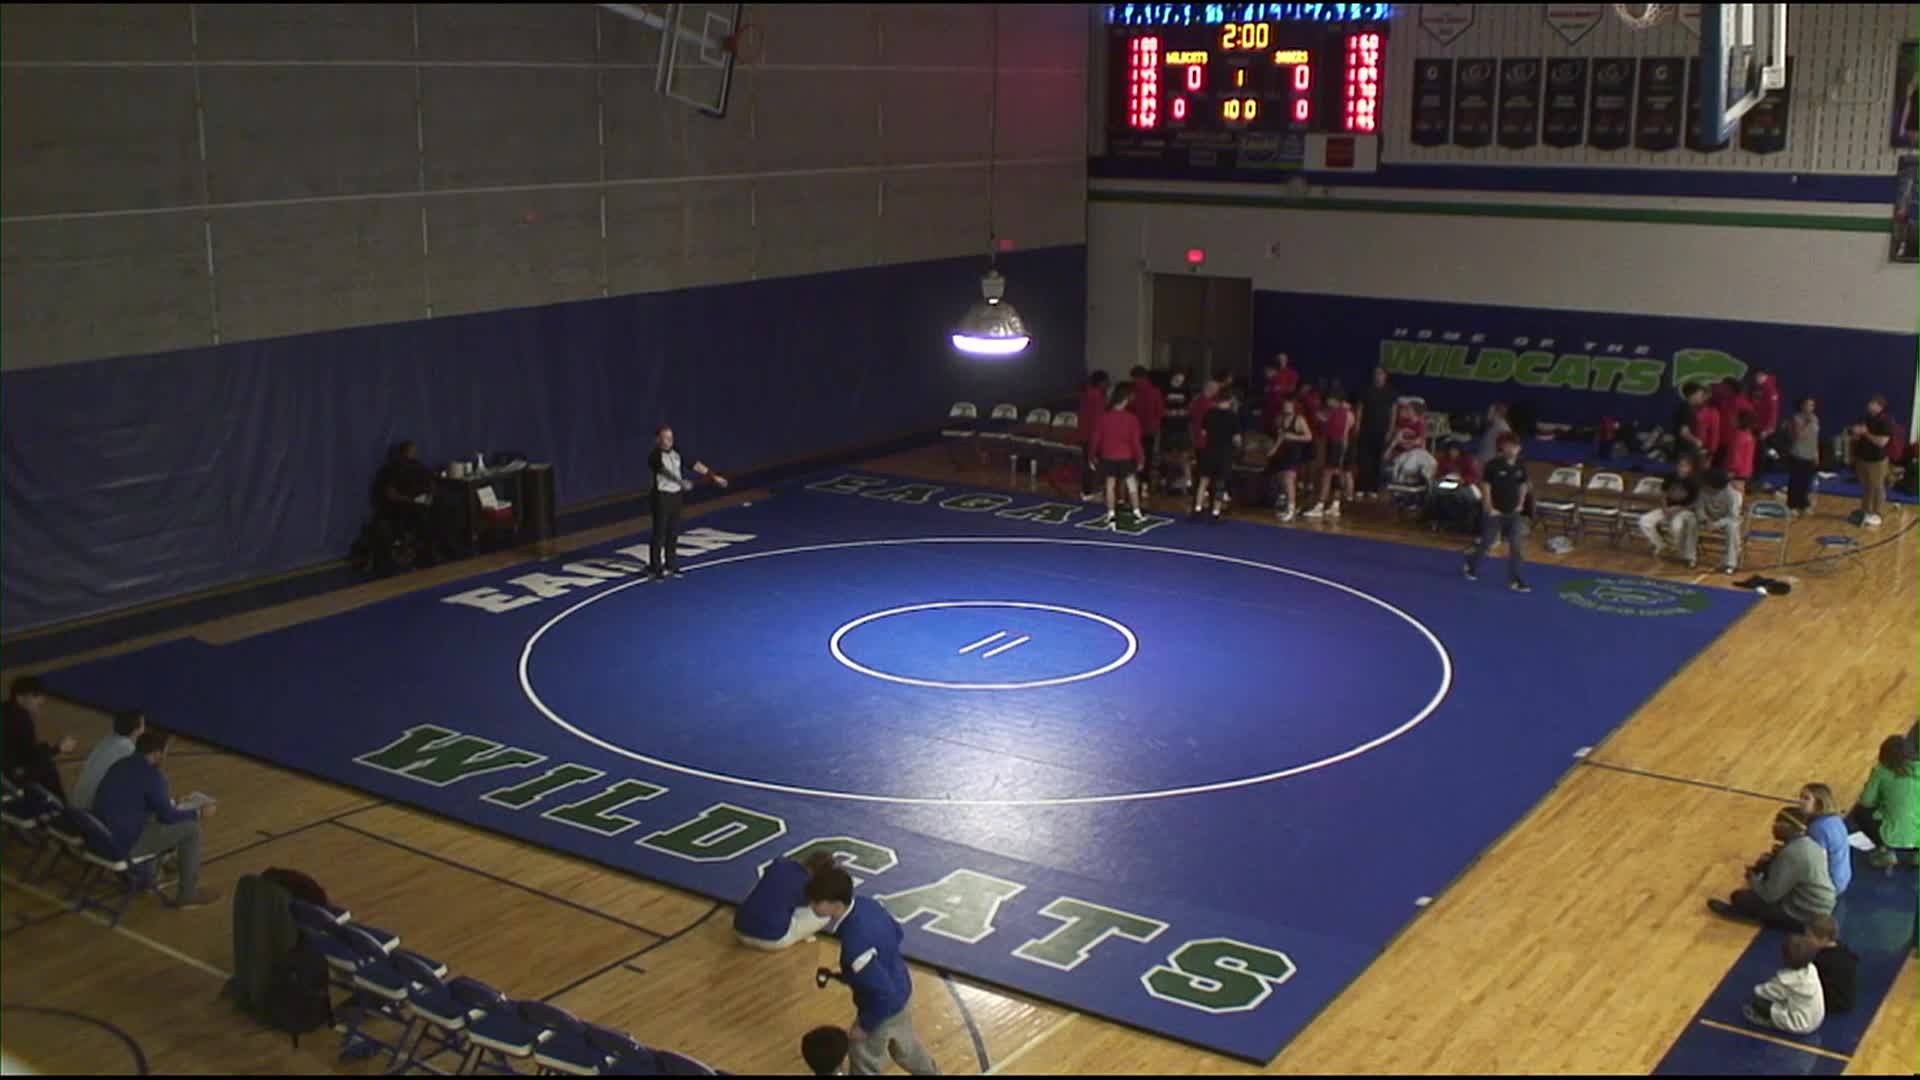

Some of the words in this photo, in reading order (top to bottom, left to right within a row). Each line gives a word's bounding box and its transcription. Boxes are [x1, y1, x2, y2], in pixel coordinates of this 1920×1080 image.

[1222, 23, 1270, 49] 2:00
[1187, 65, 1201, 91] 0
[1236, 68, 1244, 87] 1
[1294, 65, 1309, 90] 0
[1173, 98, 1186, 119] 0
[1295, 98, 1309, 119] 0
[1393, 327, 1486, 343] HOME
[1514, 336, 1555, 348] OF
[1583, 341, 1651, 355] THE
[1380, 339, 1667, 394] WILDCATS
[805, 473, 1175, 536] EAGAN
